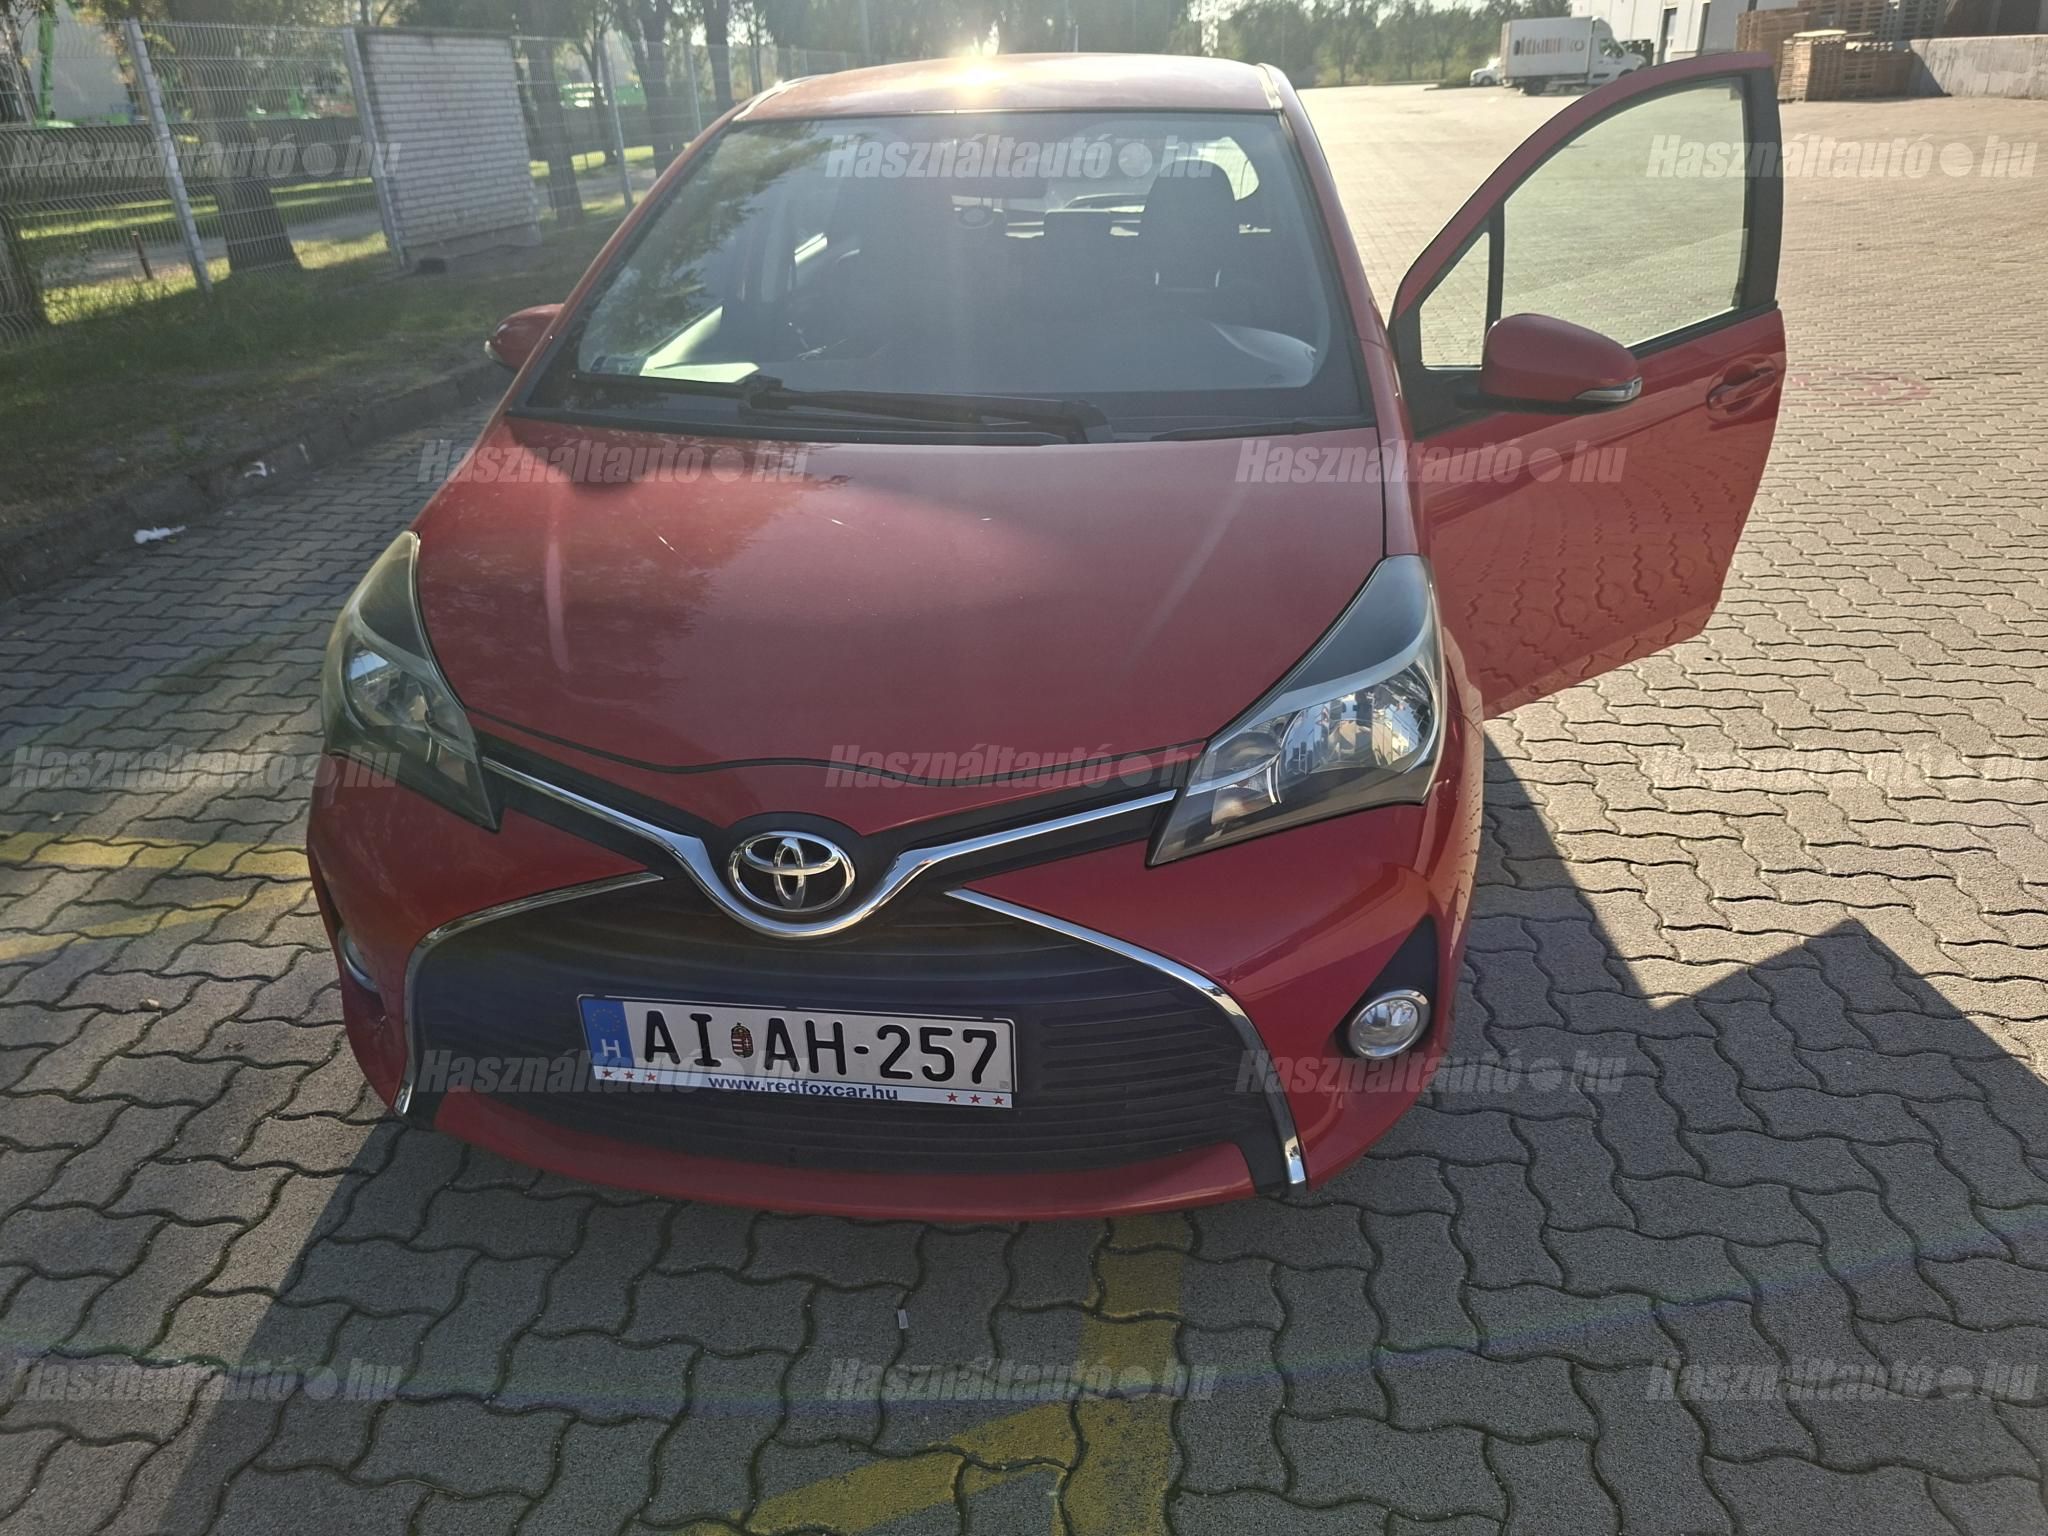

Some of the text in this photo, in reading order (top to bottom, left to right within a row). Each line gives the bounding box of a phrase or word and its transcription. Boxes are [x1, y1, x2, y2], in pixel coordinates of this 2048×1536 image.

[600, 1038, 621, 1059] H
[644, 1010, 998, 1085] AI AH-257
[708, 1076, 899, 1102] www.redfoxcar.hu
